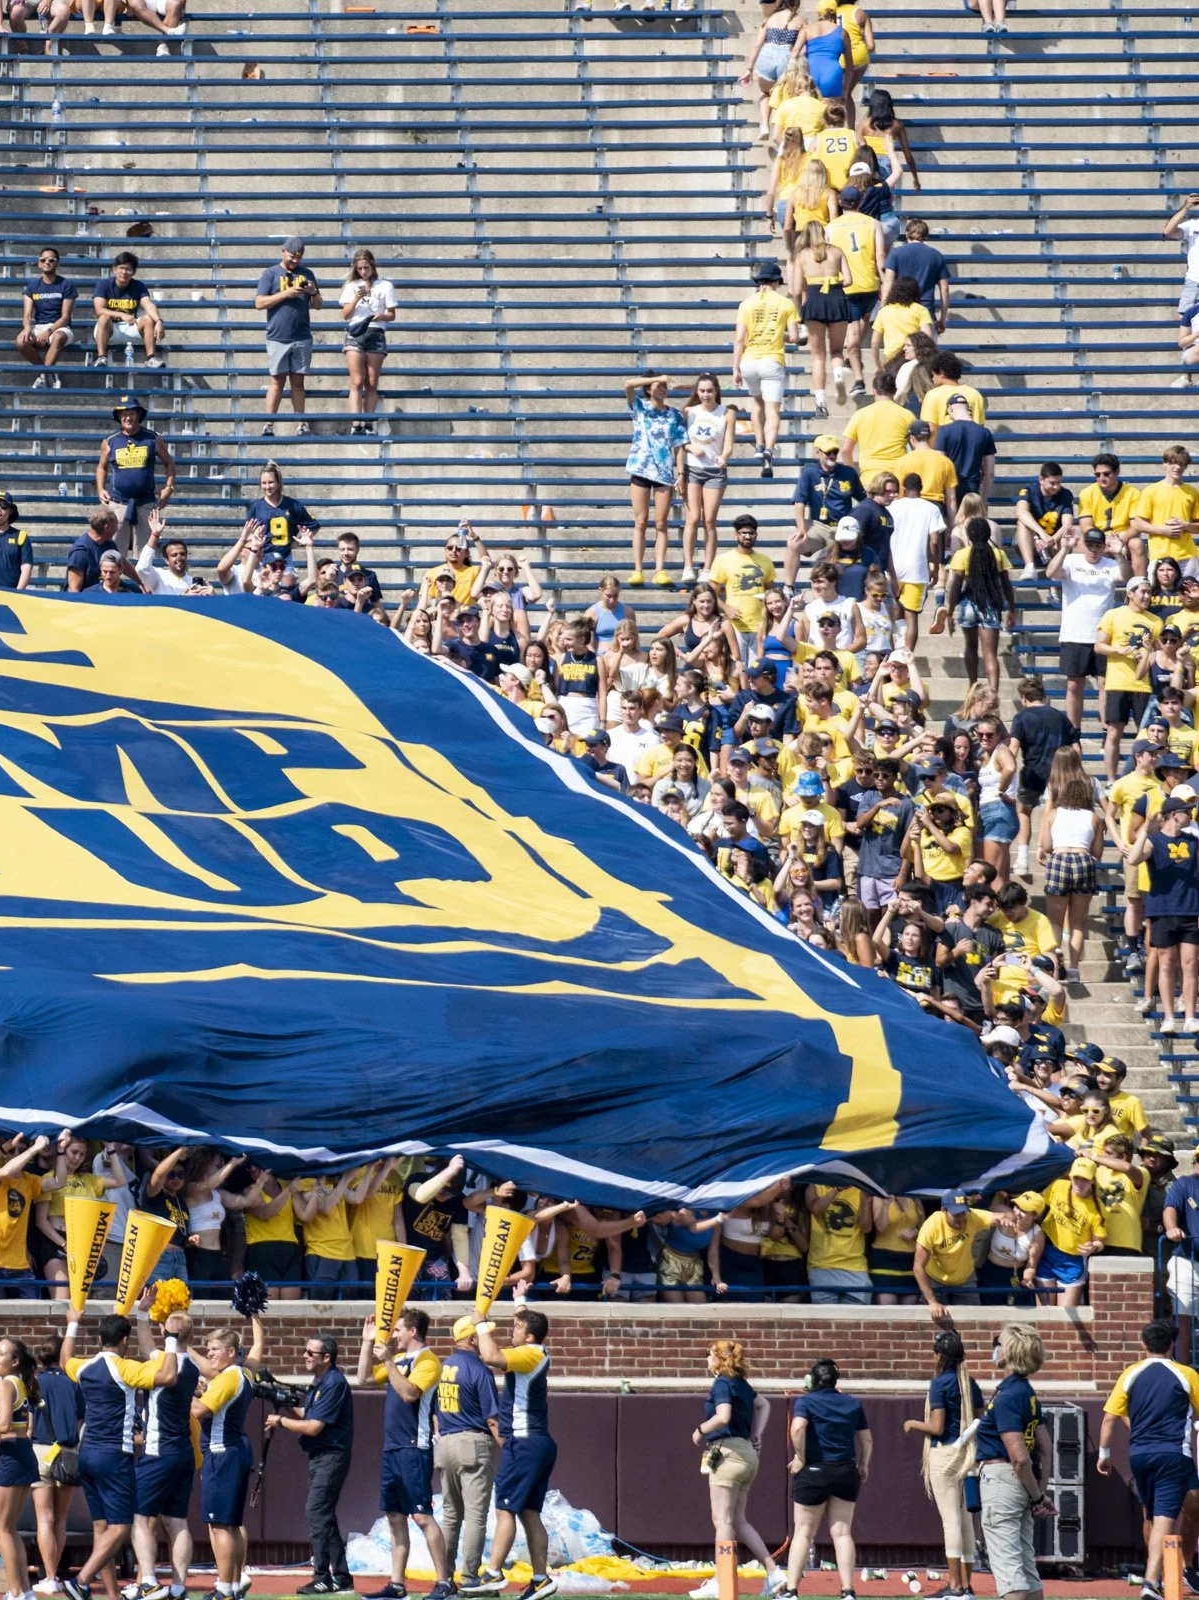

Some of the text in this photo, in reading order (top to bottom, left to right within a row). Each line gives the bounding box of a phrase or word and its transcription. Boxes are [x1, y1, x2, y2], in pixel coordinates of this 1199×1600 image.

[825, 137, 849, 155] 25
[849, 231, 859, 252] 1
[697, 426, 711, 436] M
[270, 515, 289, 547] 9
[21, 802, 492, 908] UP
[80, 1210, 110, 1294] MICHIGAN
[116, 1223, 140, 1305] MICHIGAN
[481, 1219, 512, 1300] MICHIGAN
[379, 1254, 404, 1334] MICHIGAN
